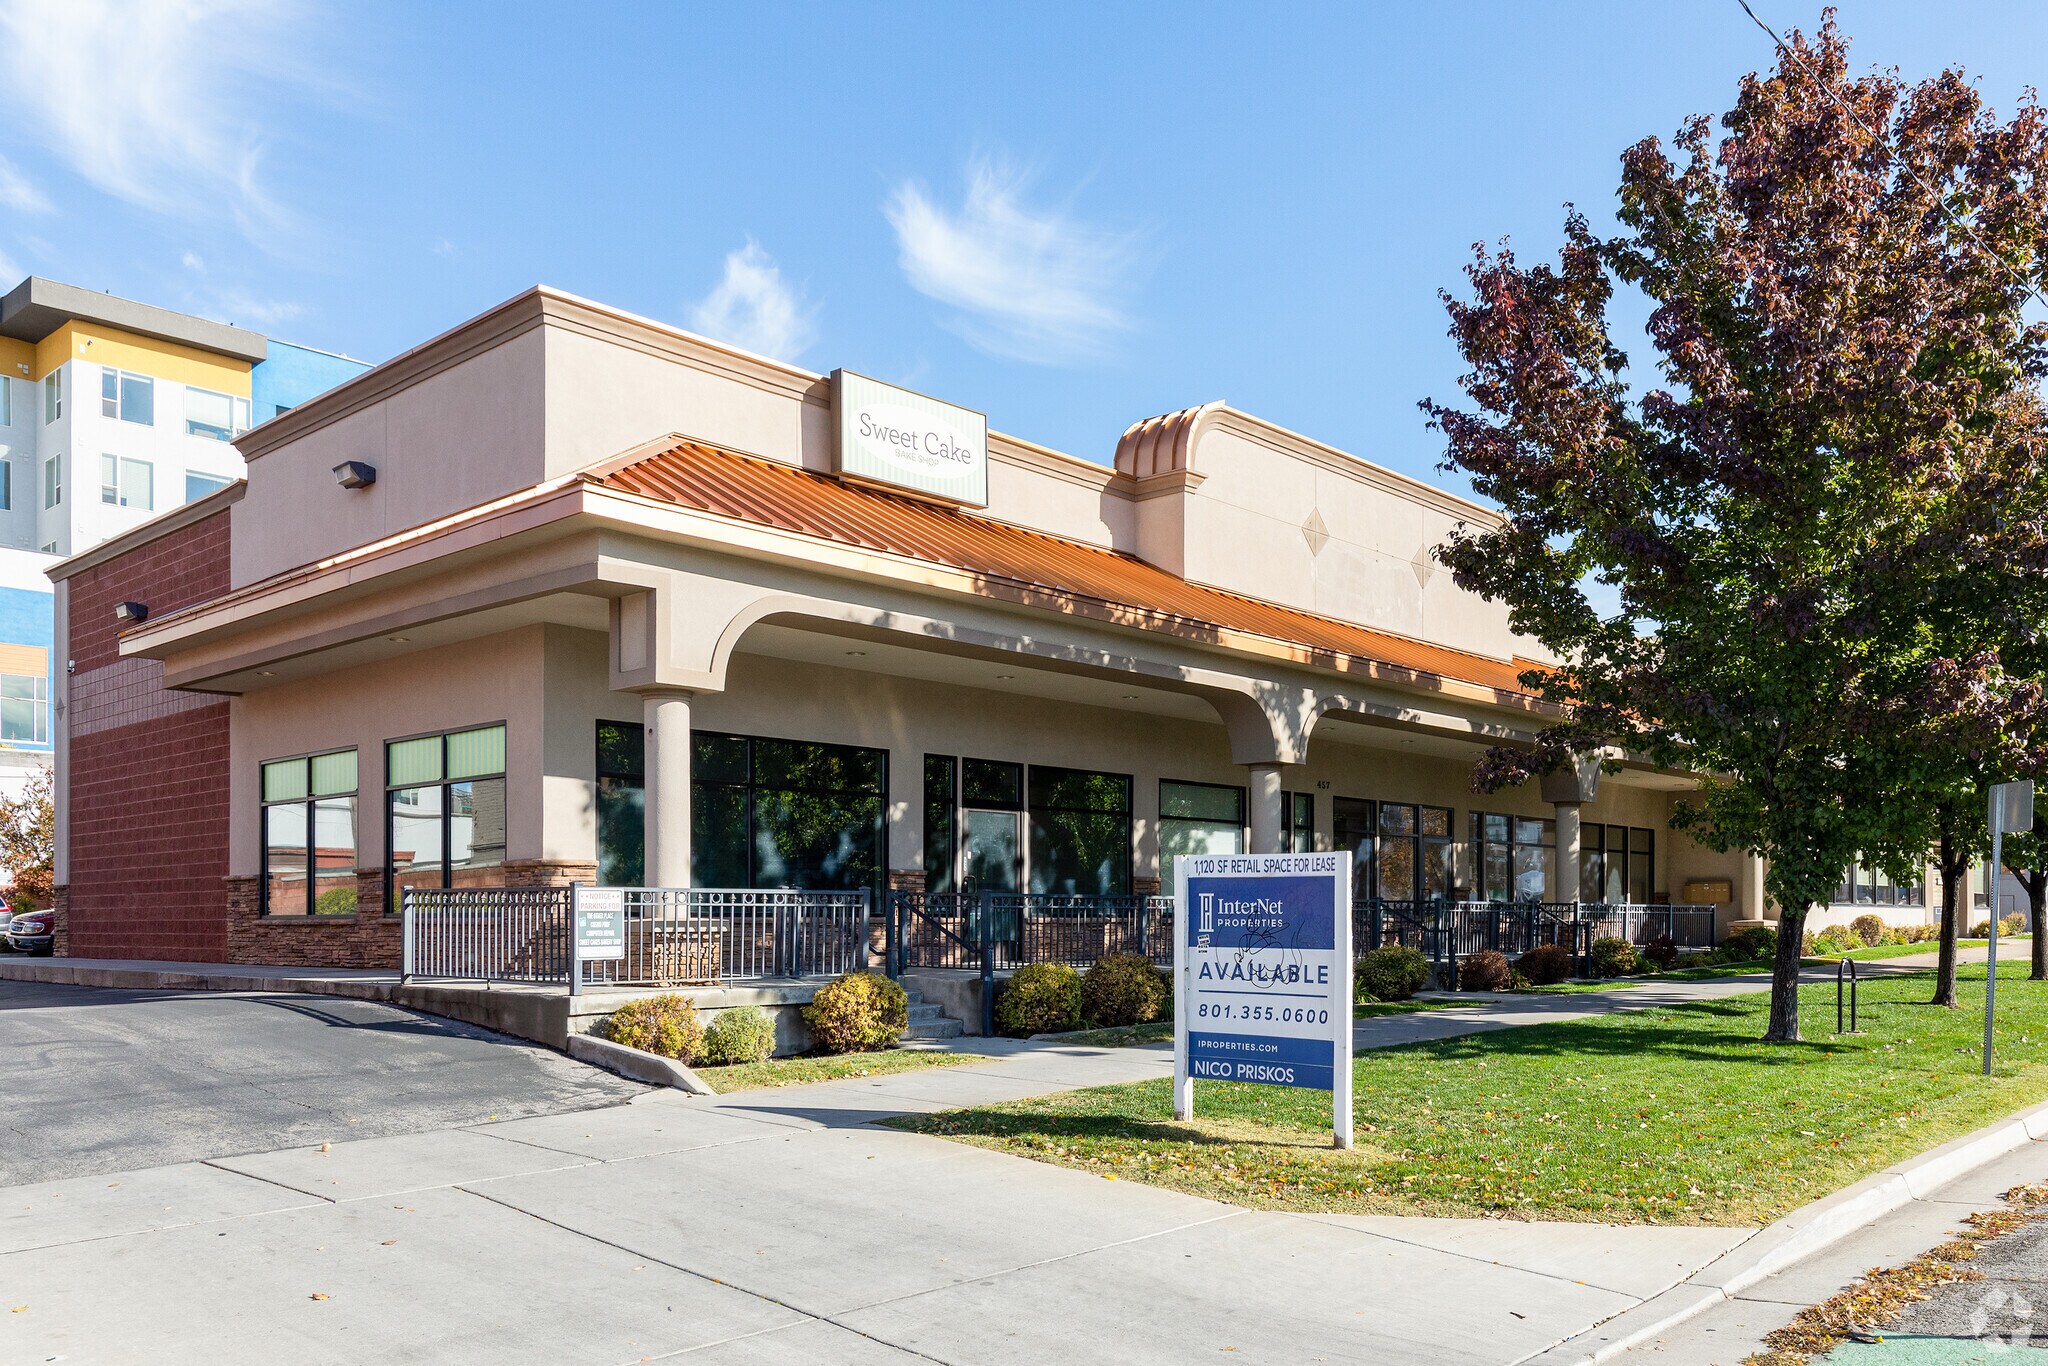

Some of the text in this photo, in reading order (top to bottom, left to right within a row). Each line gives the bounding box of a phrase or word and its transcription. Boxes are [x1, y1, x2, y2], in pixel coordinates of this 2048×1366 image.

[860, 412, 971, 465] Sweet Cake
[895, 449, 940, 467] BAKE SHOP
[1317, 781, 1330, 789] 457
[1194, 857, 1335, 875] 1,120 SF RETAIL SPACE FOR LEASE
[1217, 898, 1283, 915] InterNet
[1217, 918, 1283, 928] PROPERTIES
[1199, 962, 1328, 985] AVAILABLE
[1198, 1003, 1328, 1025] 801.355.0600
[1198, 1040, 1278, 1053] IPROPERTIES.COM
[1195, 1060, 1295, 1083] NICO PRISKOS
